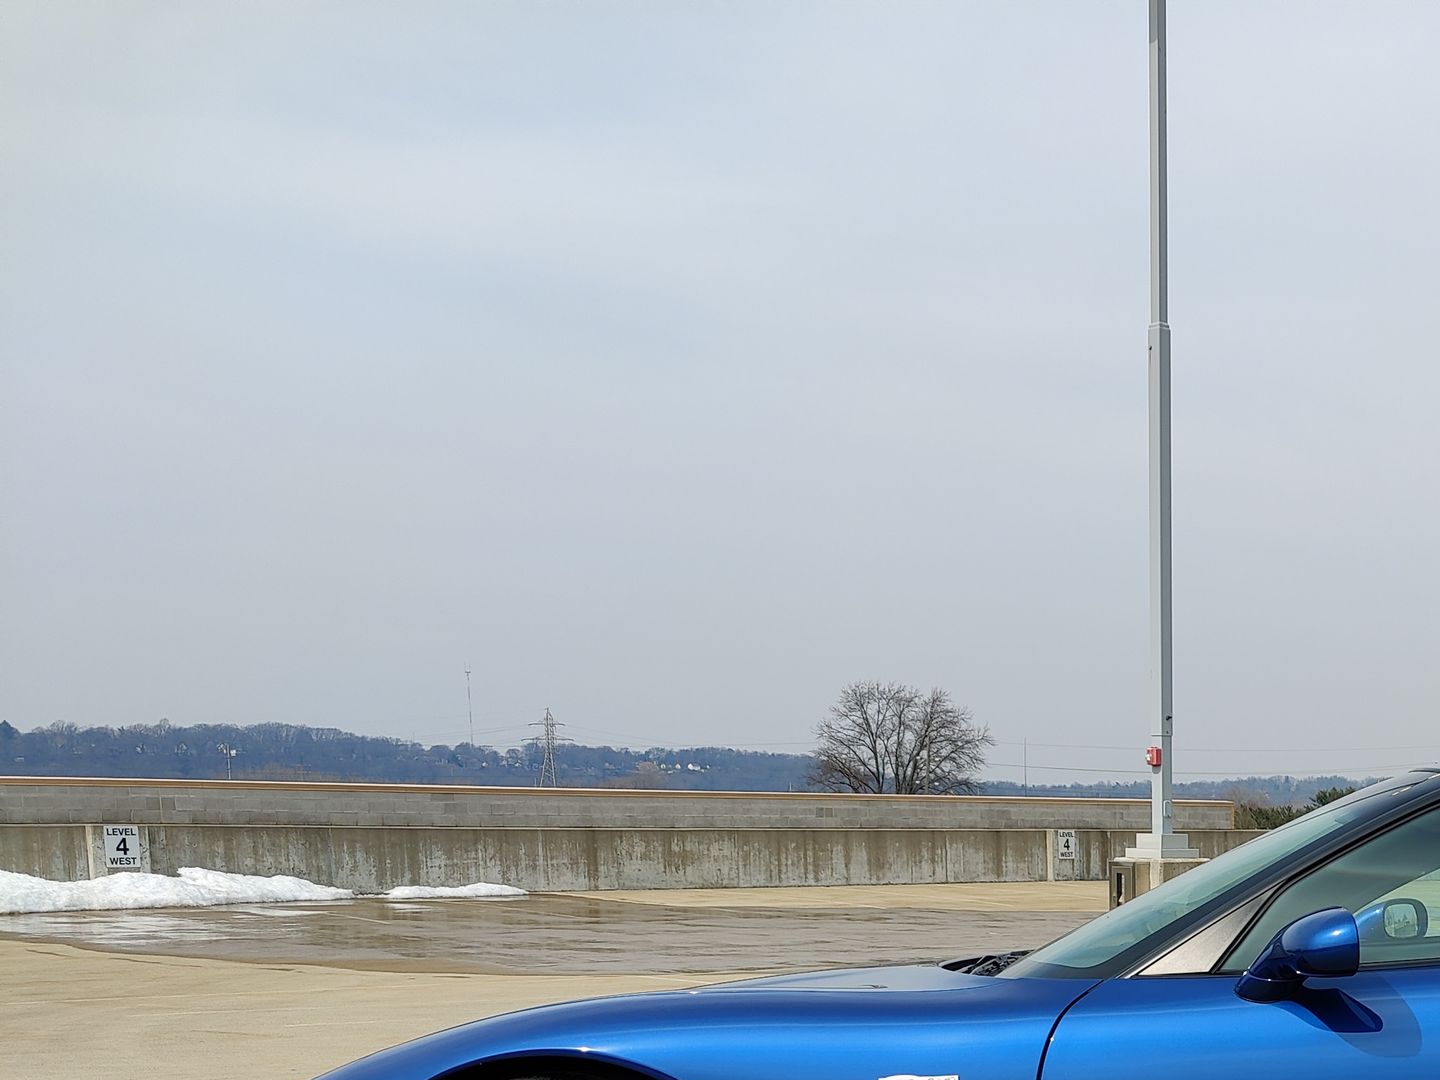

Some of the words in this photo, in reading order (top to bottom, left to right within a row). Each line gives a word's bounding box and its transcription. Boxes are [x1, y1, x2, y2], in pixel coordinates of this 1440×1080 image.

[106, 828, 136, 836] LEVEL
[116, 838, 129, 855] 4
[1063, 839, 1070, 850] 4
[110, 857, 136, 865] WEST
